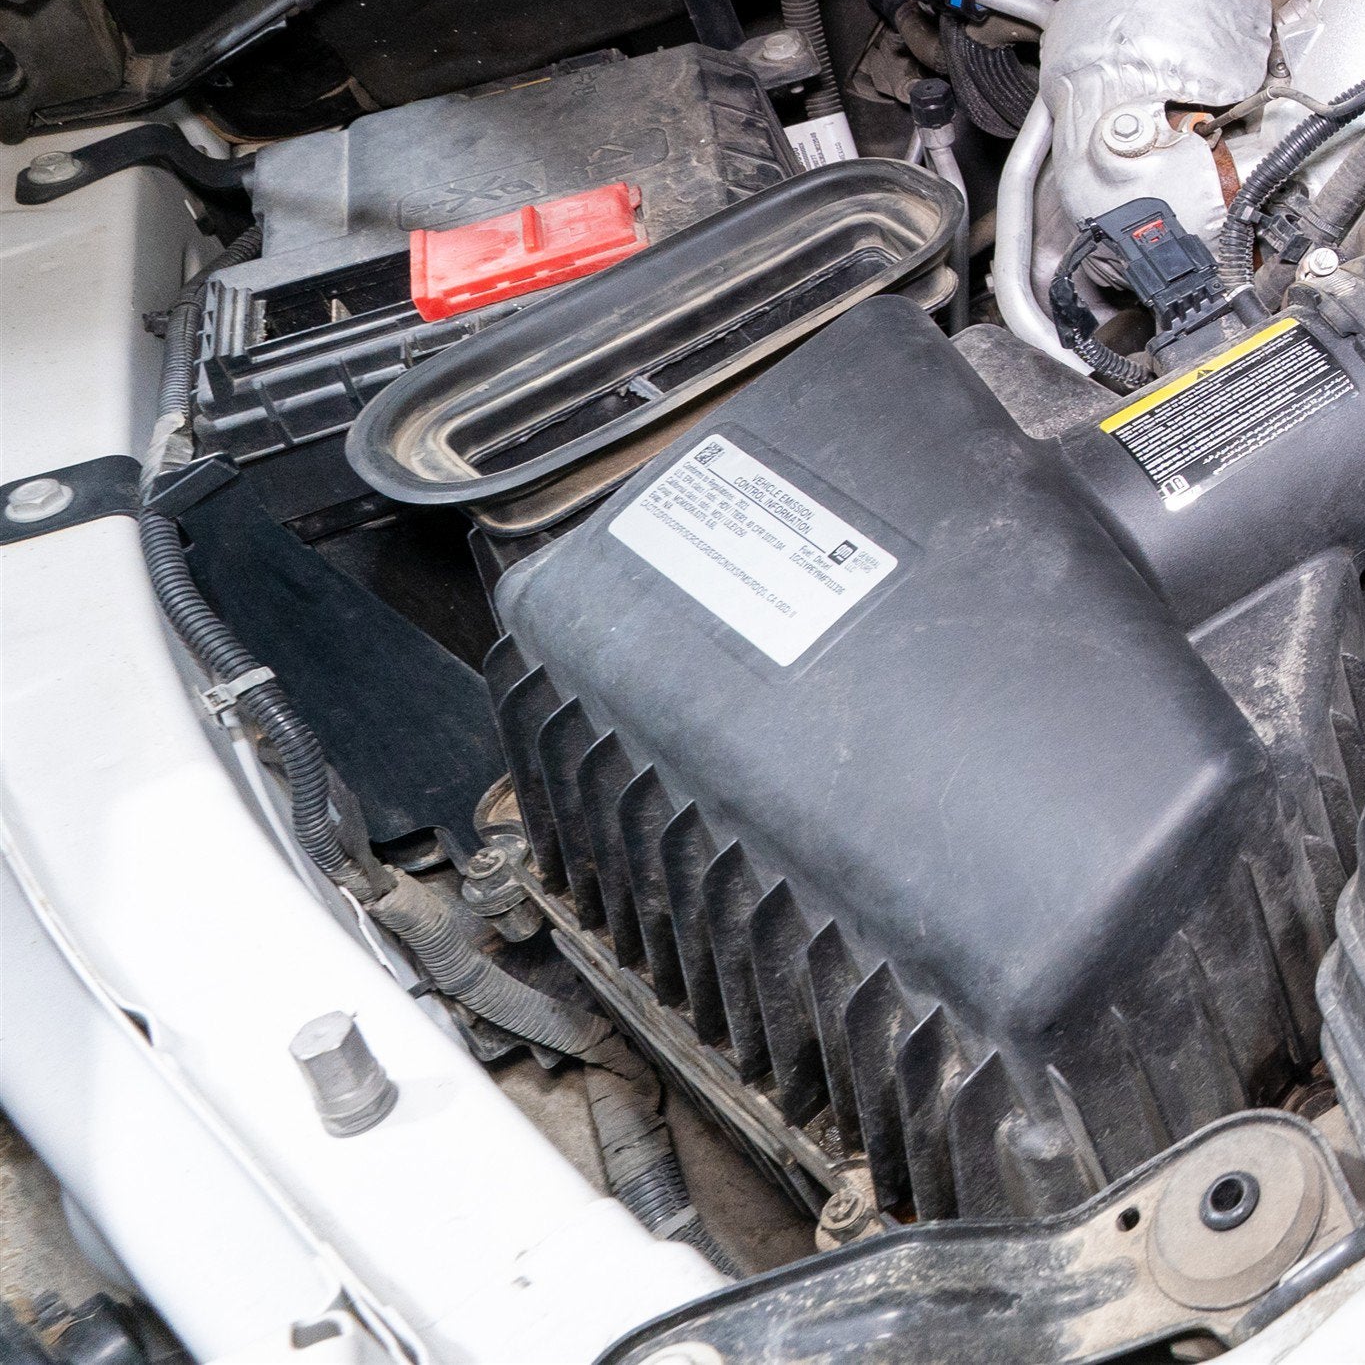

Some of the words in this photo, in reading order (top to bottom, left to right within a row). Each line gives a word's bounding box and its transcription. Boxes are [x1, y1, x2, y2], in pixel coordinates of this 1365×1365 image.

[733, 476, 766, 503] CONTROL
[763, 498, 812, 534] INFORMATION
[751, 474, 783, 498] VEHICLE
[778, 493, 814, 520] EMISSION
